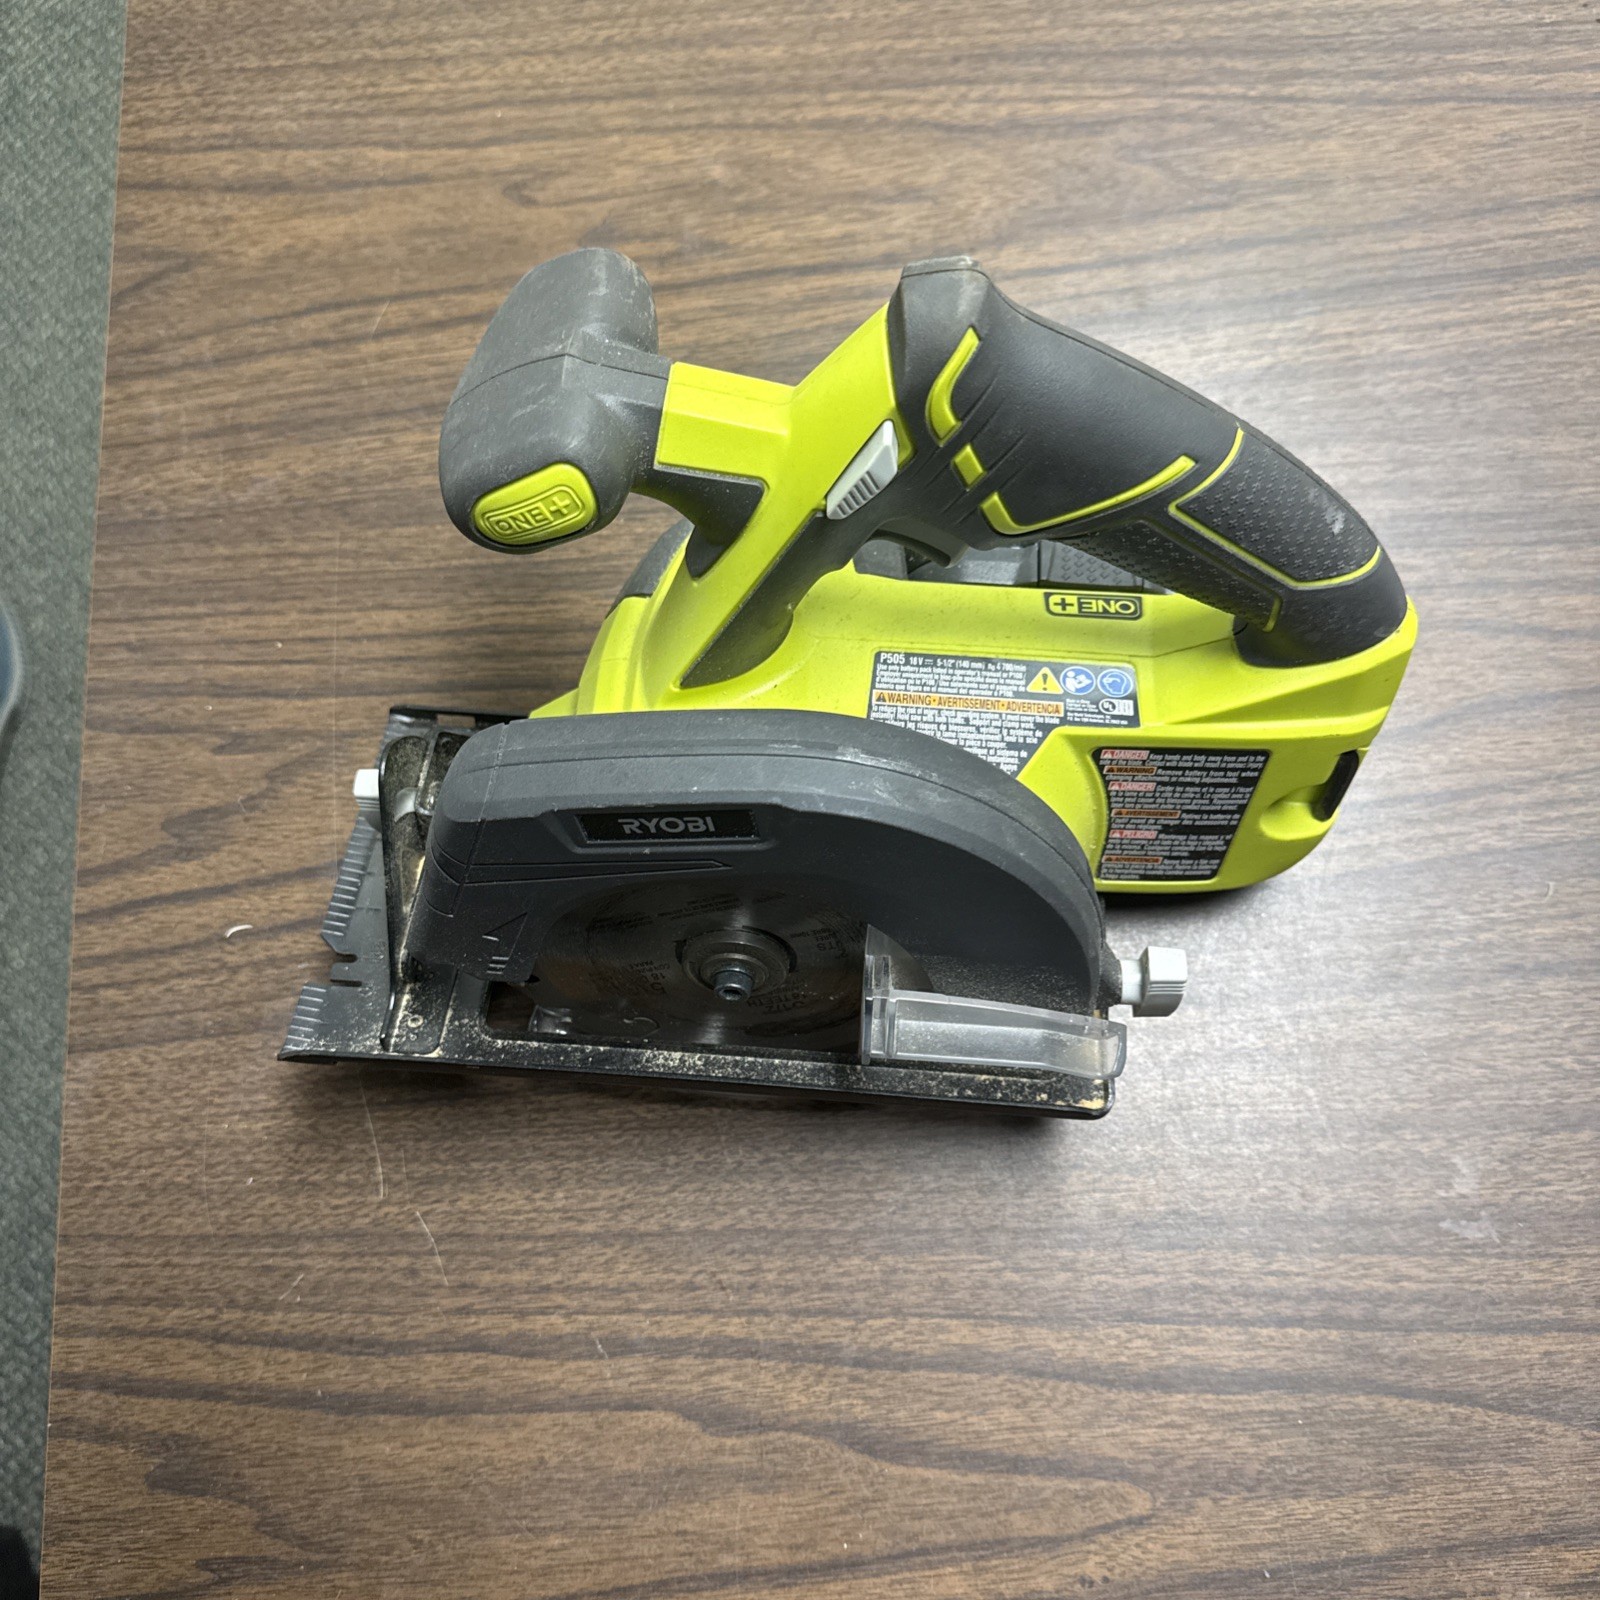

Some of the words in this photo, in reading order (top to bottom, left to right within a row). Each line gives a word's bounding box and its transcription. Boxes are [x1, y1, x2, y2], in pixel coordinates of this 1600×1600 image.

[880, 653, 905, 664] P505
[910, 657, 917, 665] 18
[887, 692, 932, 706] WARNING
[937, 696, 1001, 709] AVERTISSEMENT
[1007, 700, 1061, 715] ADVERTENCIA
[618, 816, 716, 835] RYOBI
